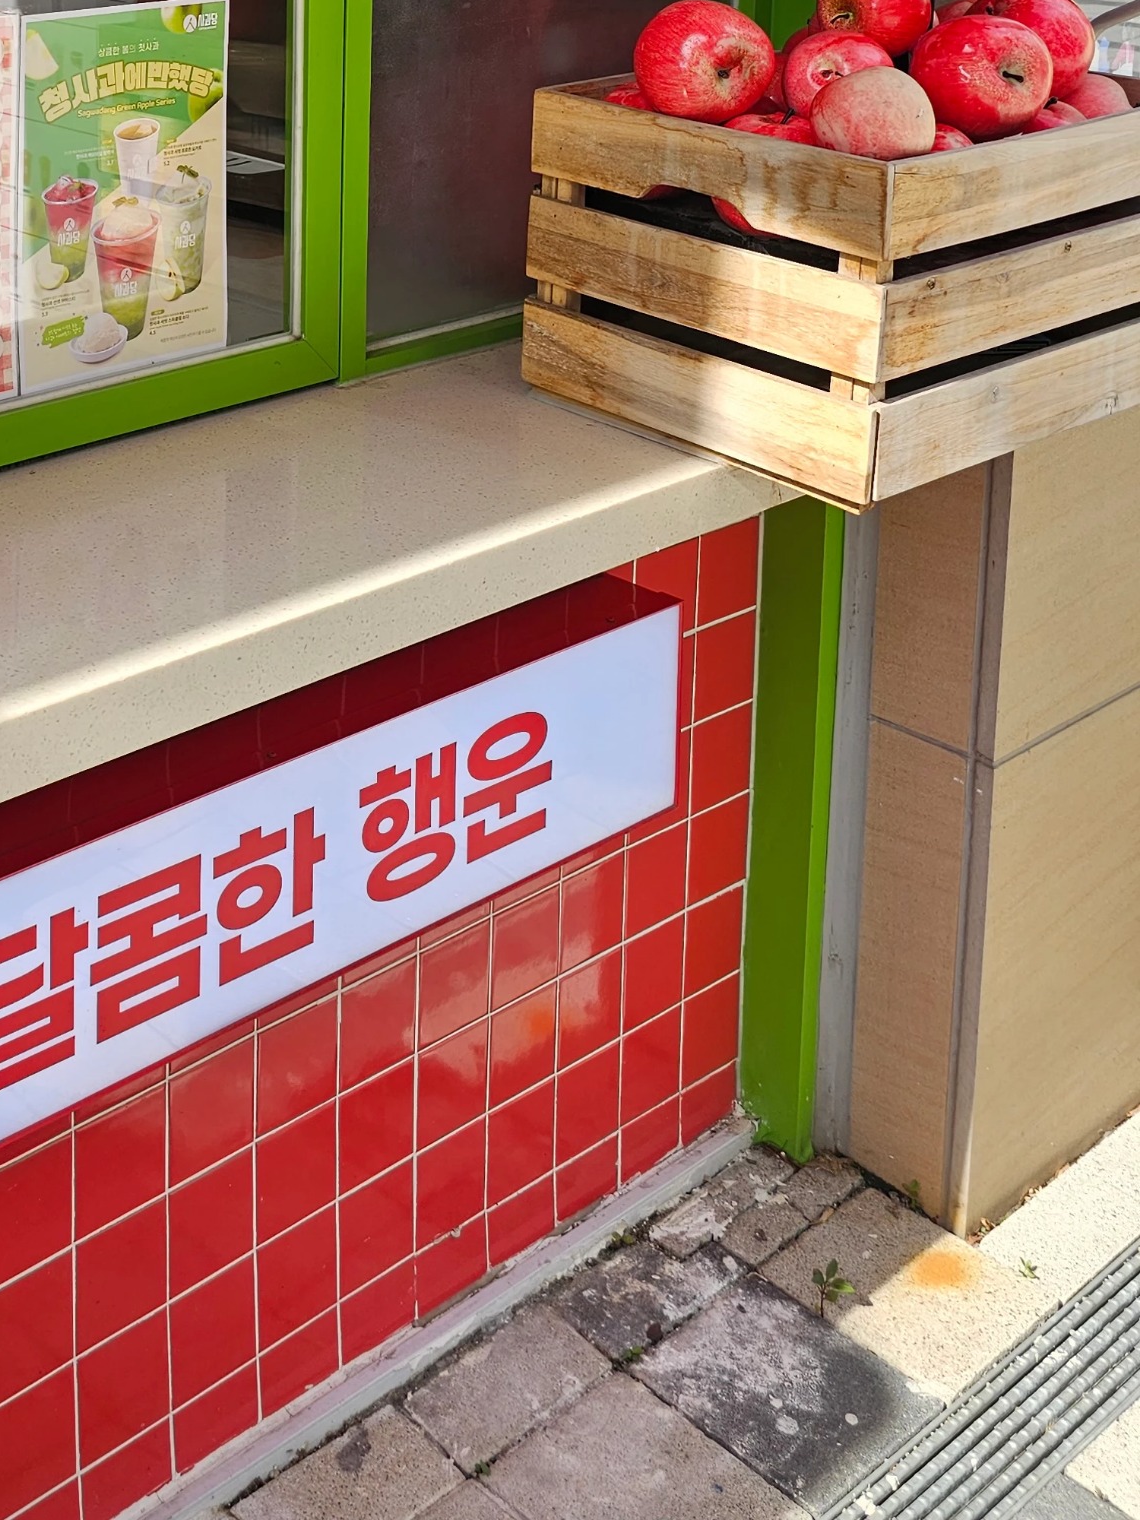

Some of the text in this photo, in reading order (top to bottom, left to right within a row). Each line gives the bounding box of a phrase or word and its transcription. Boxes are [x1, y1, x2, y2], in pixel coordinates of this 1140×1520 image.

[197, 13, 218, 28] 사과당
[138, 41, 159, 53] 첫사과
[77, 97, 176, 119] Sagwadang Green Apple Series
[57, 231, 81, 247] 사과당
[174, 233, 196, 250] 사과당
[114, 281, 138, 298] 사과당
[358, 711, 553, 902] 행운
